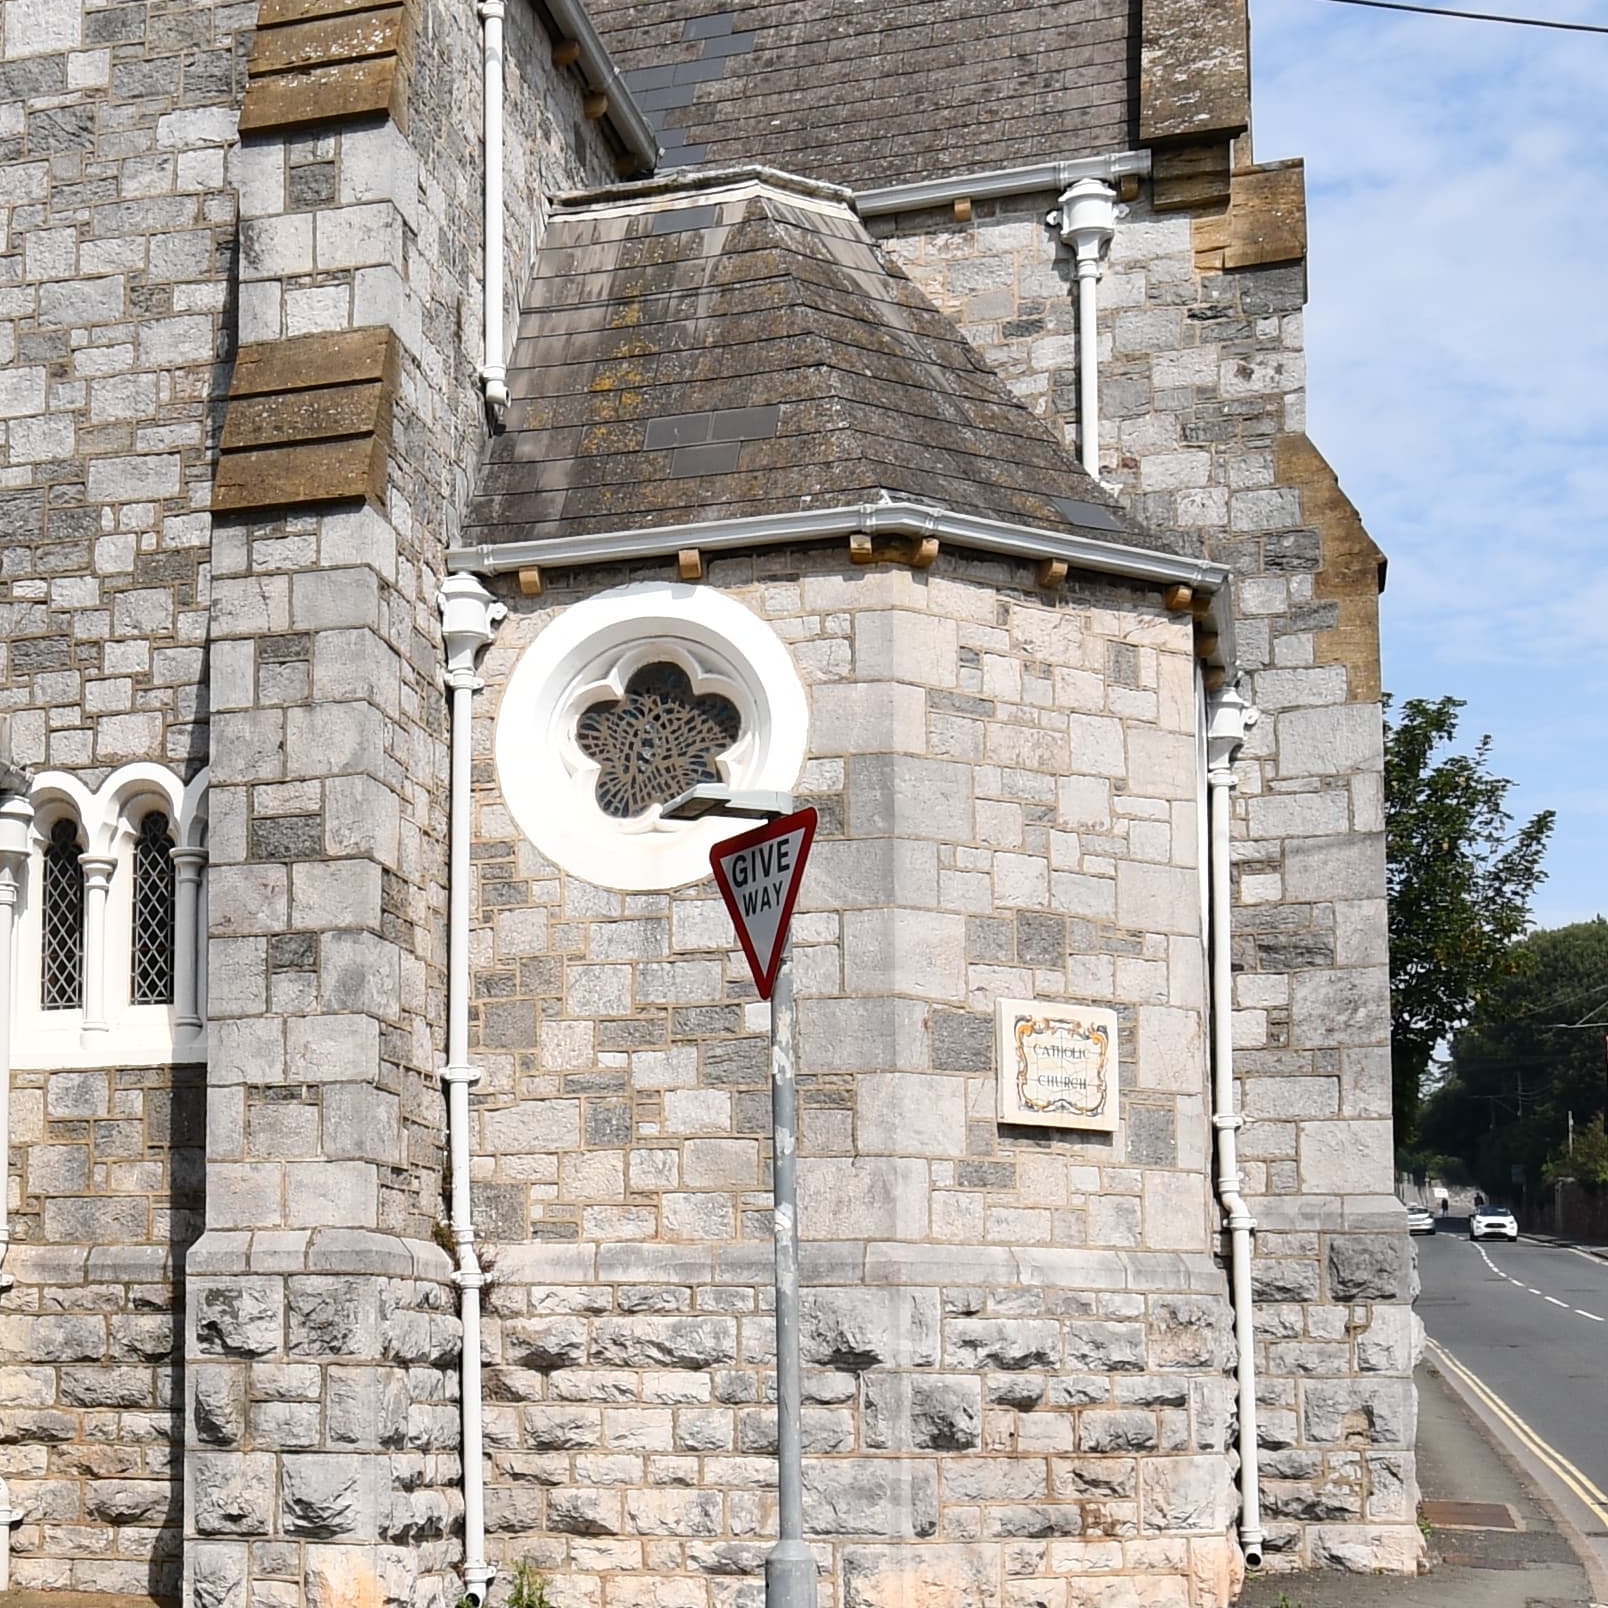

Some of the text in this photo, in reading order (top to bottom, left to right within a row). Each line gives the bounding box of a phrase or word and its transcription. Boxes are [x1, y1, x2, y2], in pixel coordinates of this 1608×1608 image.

[732, 838, 790, 888] GIVE
[742, 880, 784, 917] WAY
[1033, 1043, 1089, 1059] CATHOLIC
[1038, 1074, 1087, 1090] CHURCH
